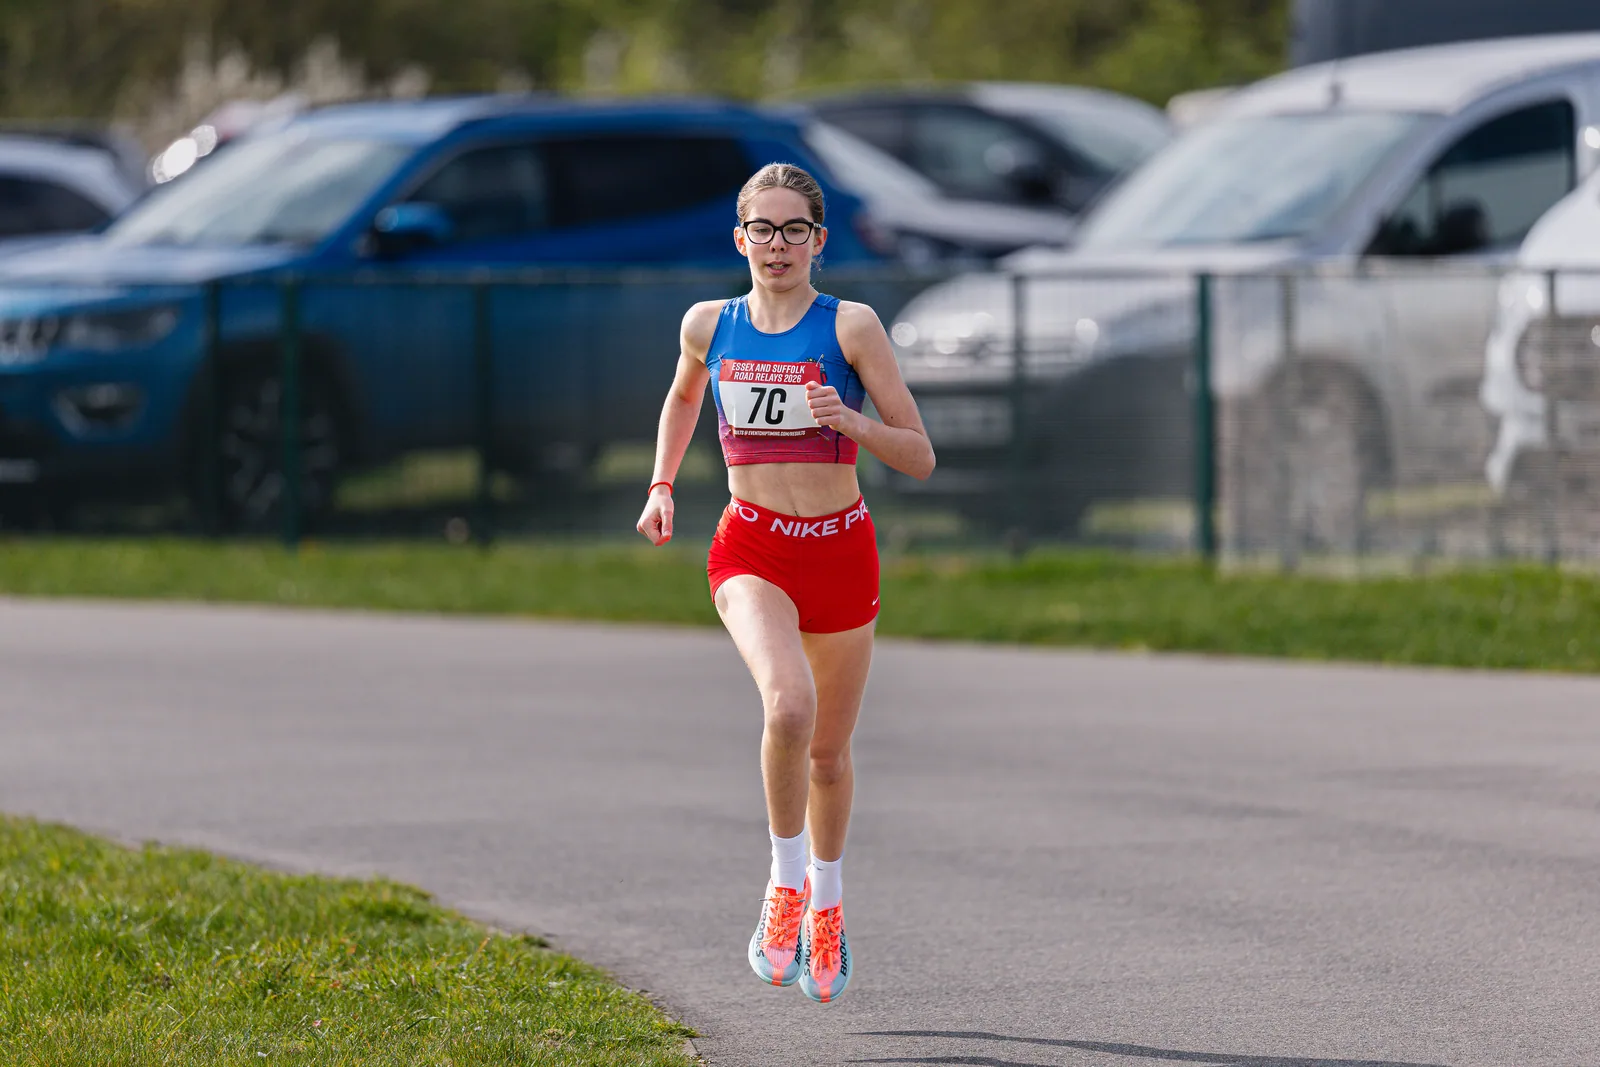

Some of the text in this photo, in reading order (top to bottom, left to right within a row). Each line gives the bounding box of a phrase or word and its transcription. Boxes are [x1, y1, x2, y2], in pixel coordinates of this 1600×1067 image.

[732, 362, 806, 374] ESSEX AND SUFFOLK
[733, 371, 802, 383] ROAD RELAYS 2026
[747, 387, 787, 425] 7C
[770, 518, 839, 538] NIKE
